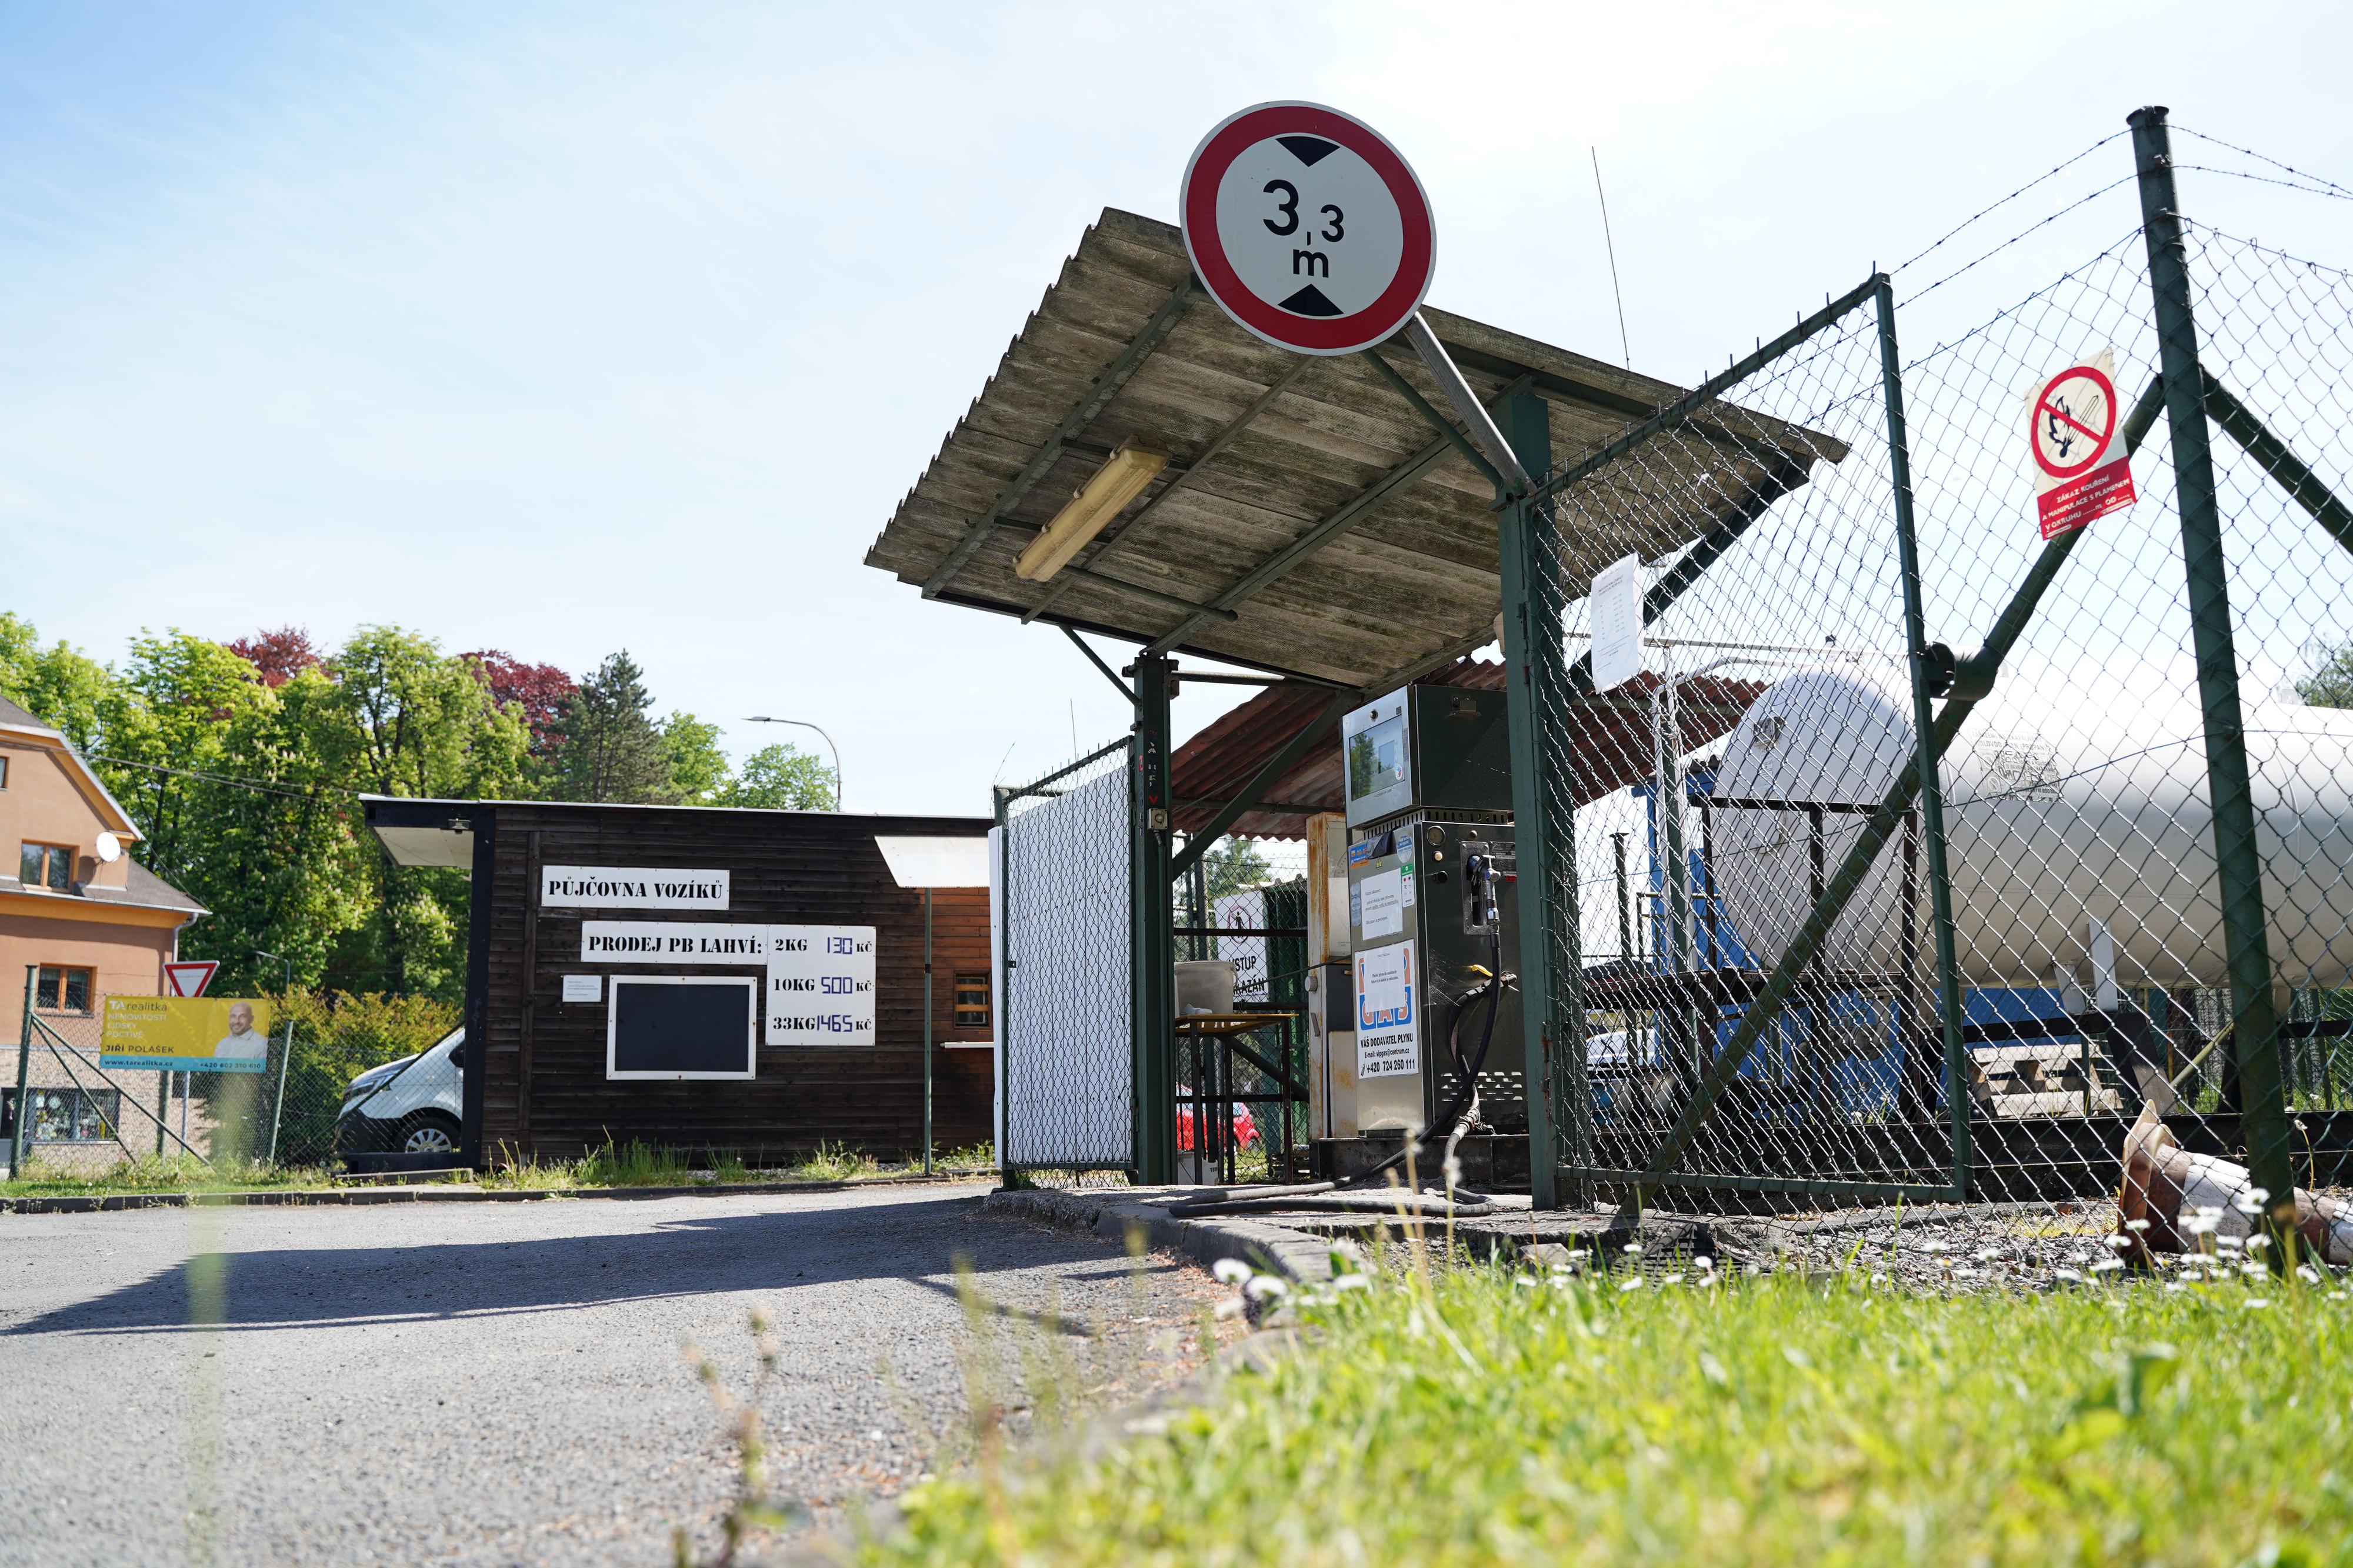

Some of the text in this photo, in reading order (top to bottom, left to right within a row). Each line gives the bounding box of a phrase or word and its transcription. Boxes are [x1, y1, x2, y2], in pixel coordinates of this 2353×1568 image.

[1293, 249, 1329, 278] m
[2057, 474, 2109, 503] ZÁKAZ KOUŘENÍ
[2048, 498, 2088, 518] MANIPULACE
[2095, 478, 2130, 498] PLAMENEM
[2051, 511, 2081, 528] OKRUHU
[2105, 496, 2117, 505] OD
[548, 876, 722, 899] PŮJČOVNA VOZÍKŮ
[588, 935, 762, 954] PRODEJ PB LAHVÍ:
[775, 937, 872, 955] 2KG 130 KČ
[775, 977, 872, 994] 10KG 500 KČ
[127, 1002, 167, 1011] realitka
[108, 1013, 166, 1021] NEMOVITOSTI
[773, 1015, 871, 1032] 33KG 1465 KČ
[105, 1043, 125, 1052] JIŘÍ
[1361, 1033, 1413, 1048] VÁŠ DODAVATEL PLYNU
[1377, 1048, 1409, 1057] vipgas@centrum.cz
[1367, 1059, 1415, 1073] +420 724 260 111
